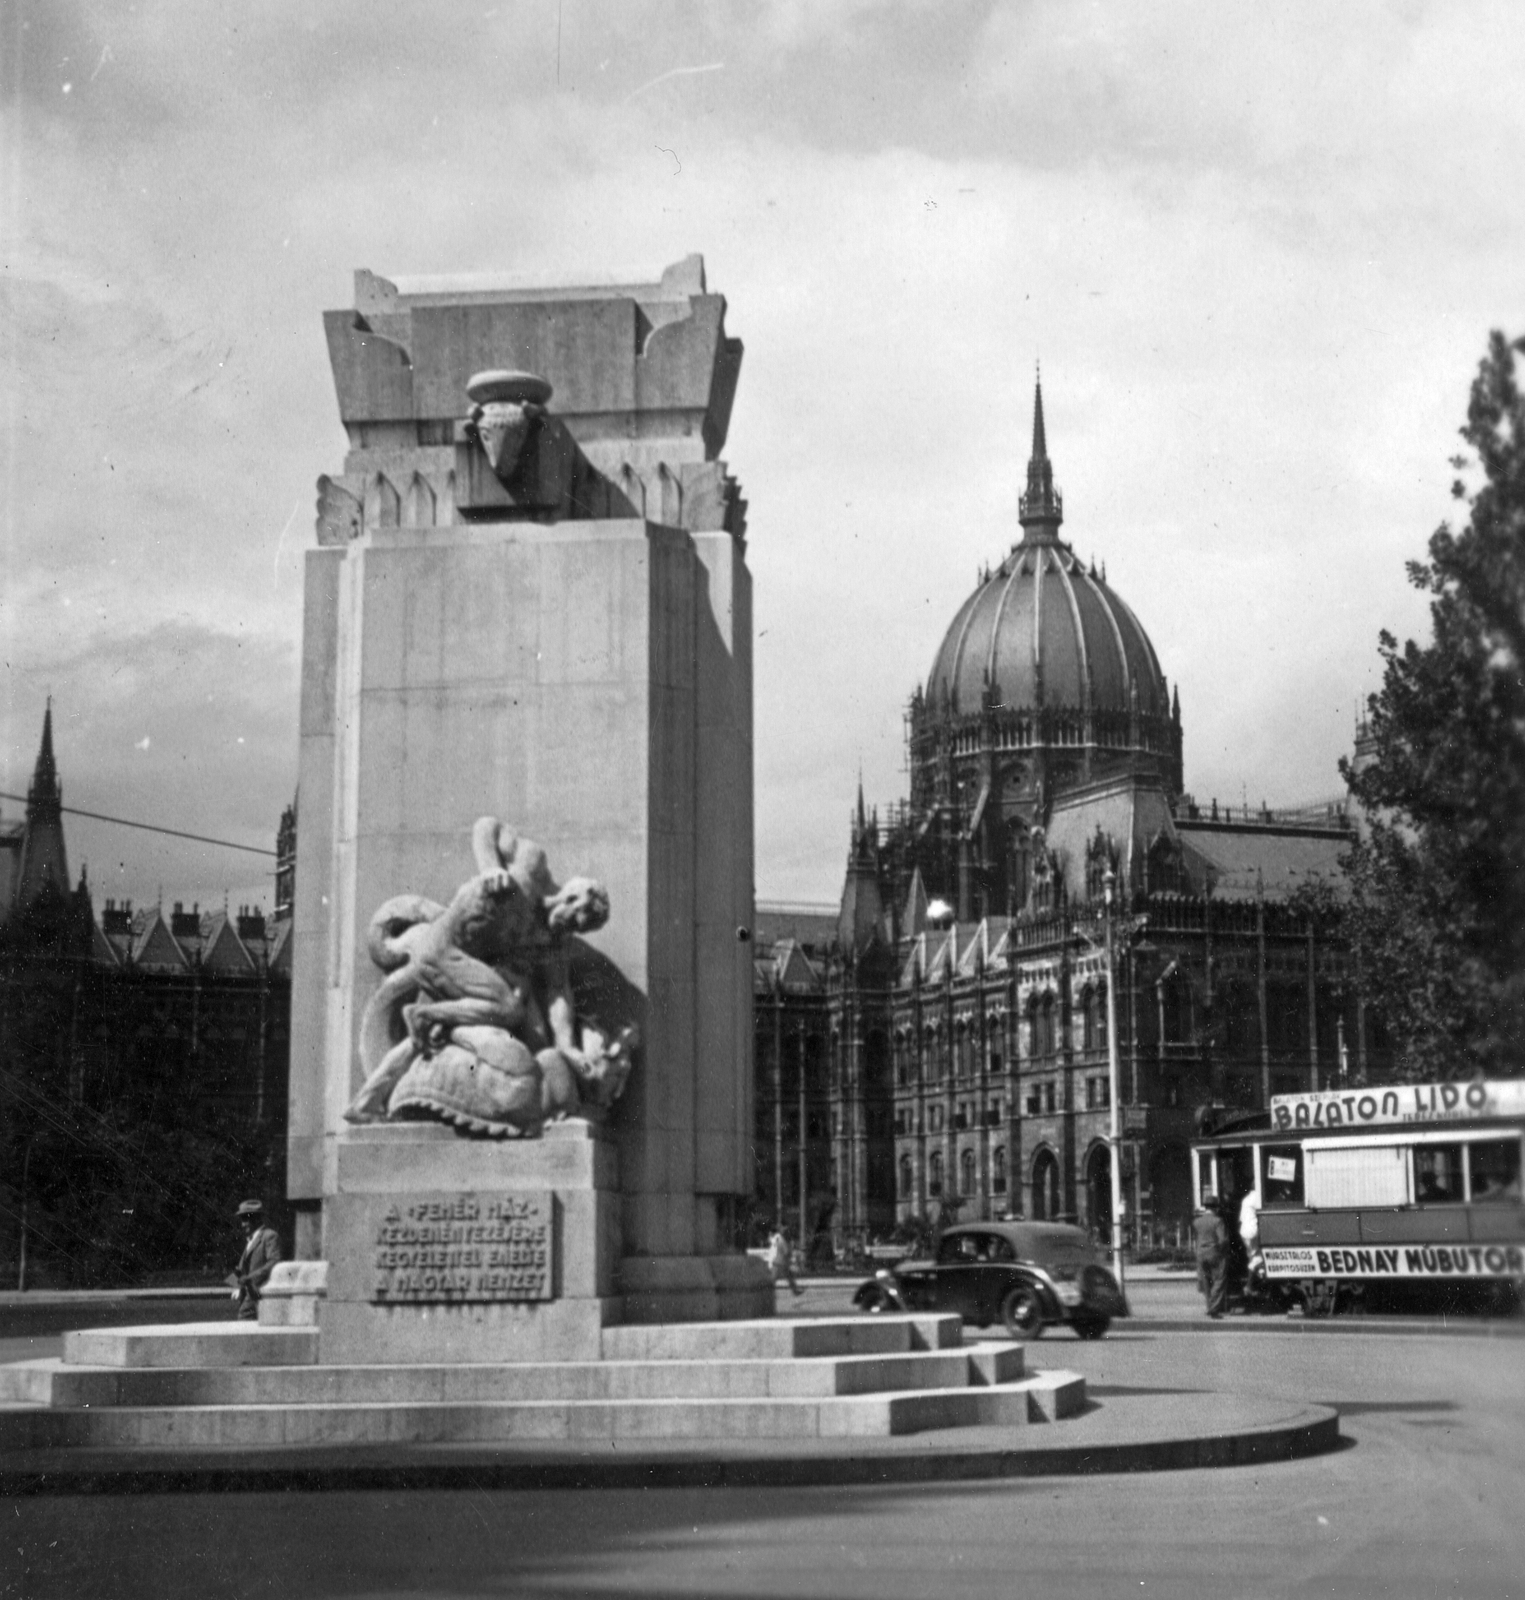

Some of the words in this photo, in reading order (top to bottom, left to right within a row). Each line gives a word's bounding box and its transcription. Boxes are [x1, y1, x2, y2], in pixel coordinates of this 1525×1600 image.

[1274, 1091, 1399, 1131] BALATON
[1414, 1083, 1487, 1112] LIDO
[385, 1203, 401, 1221] A
[1316, 1249, 1399, 1273] BEDNAY
[375, 1274, 390, 1293] A
[397, 1274, 470, 1293] MAGYAR
